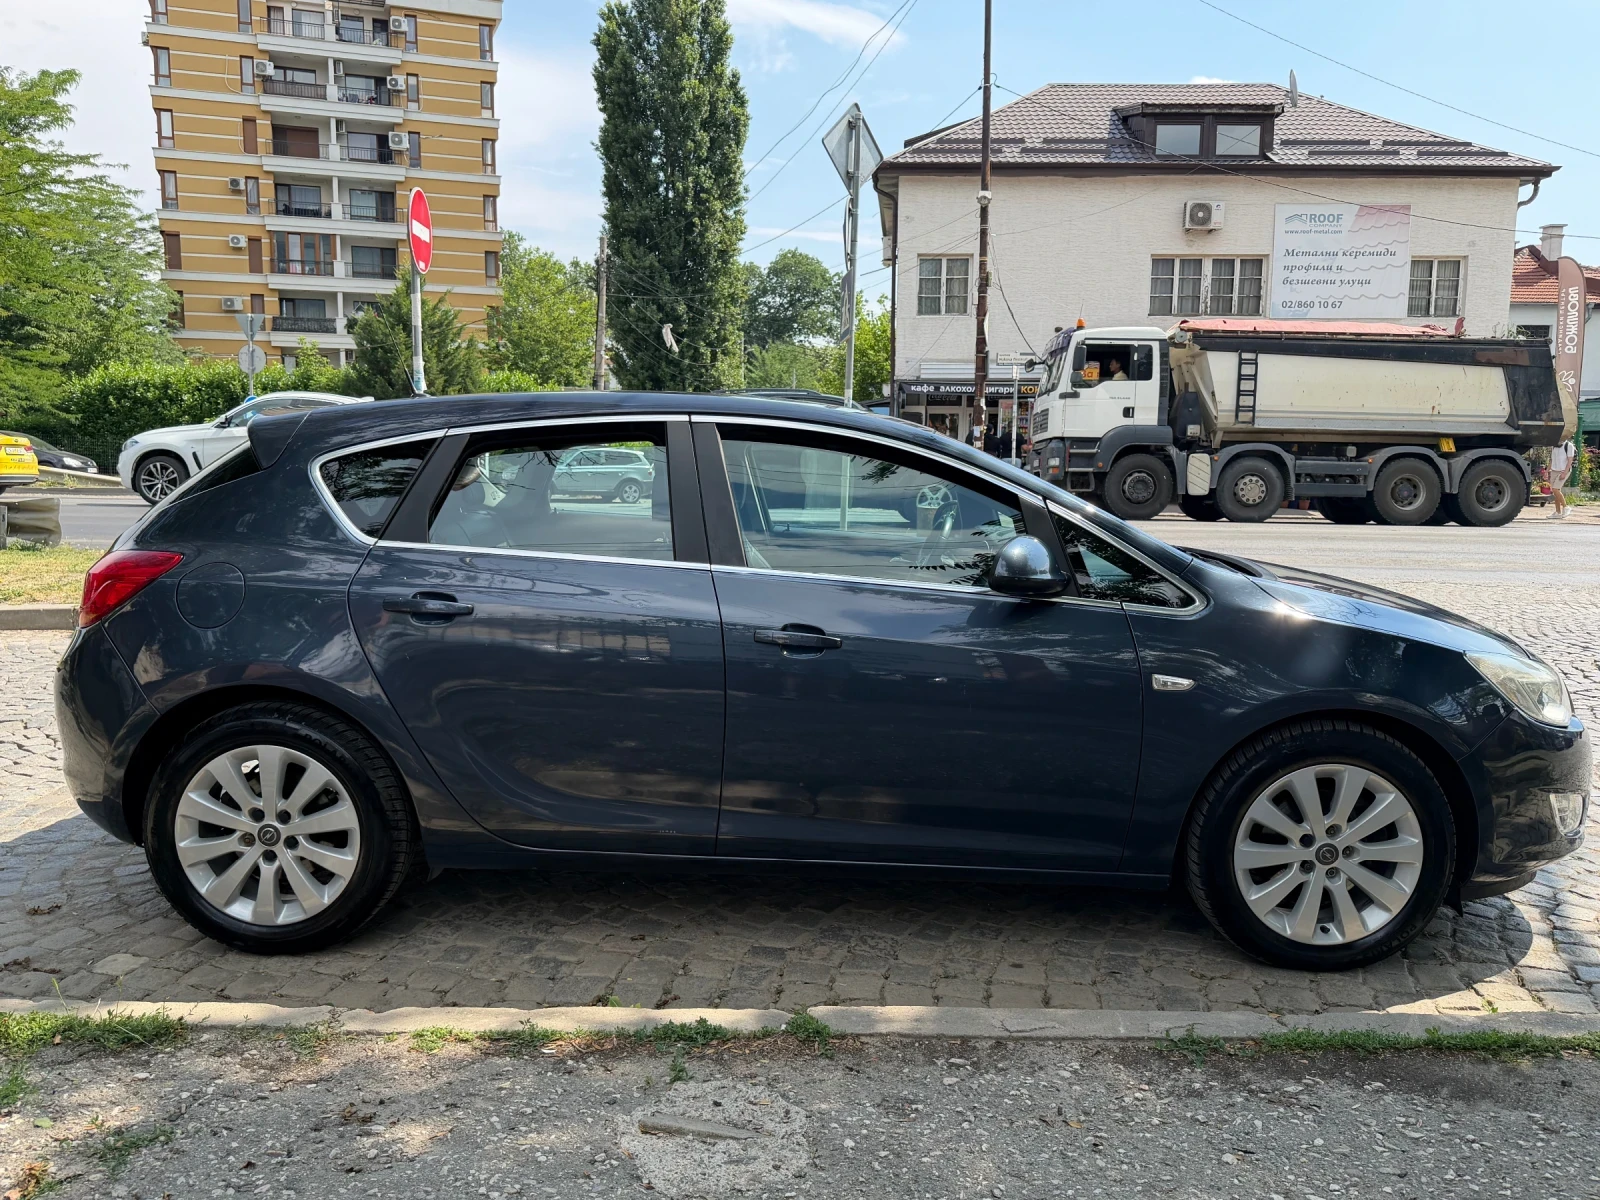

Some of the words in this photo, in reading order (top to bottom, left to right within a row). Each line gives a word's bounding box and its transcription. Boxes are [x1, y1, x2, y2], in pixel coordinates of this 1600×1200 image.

[1309, 214, 1343, 223] ROOF
[1283, 249, 1339, 257] Метални
[1341, 248, 1397, 259] керемиди
[1282, 263, 1333, 273] профили
[1282, 276, 1336, 286] безшевни
[1339, 278, 1371, 288] улуци
[1281, 301, 1315, 309] 02/860
[1318, 301, 1328, 309] 10
[1330, 301, 1343, 309] 67
[911, 383, 935, 393] кафе
